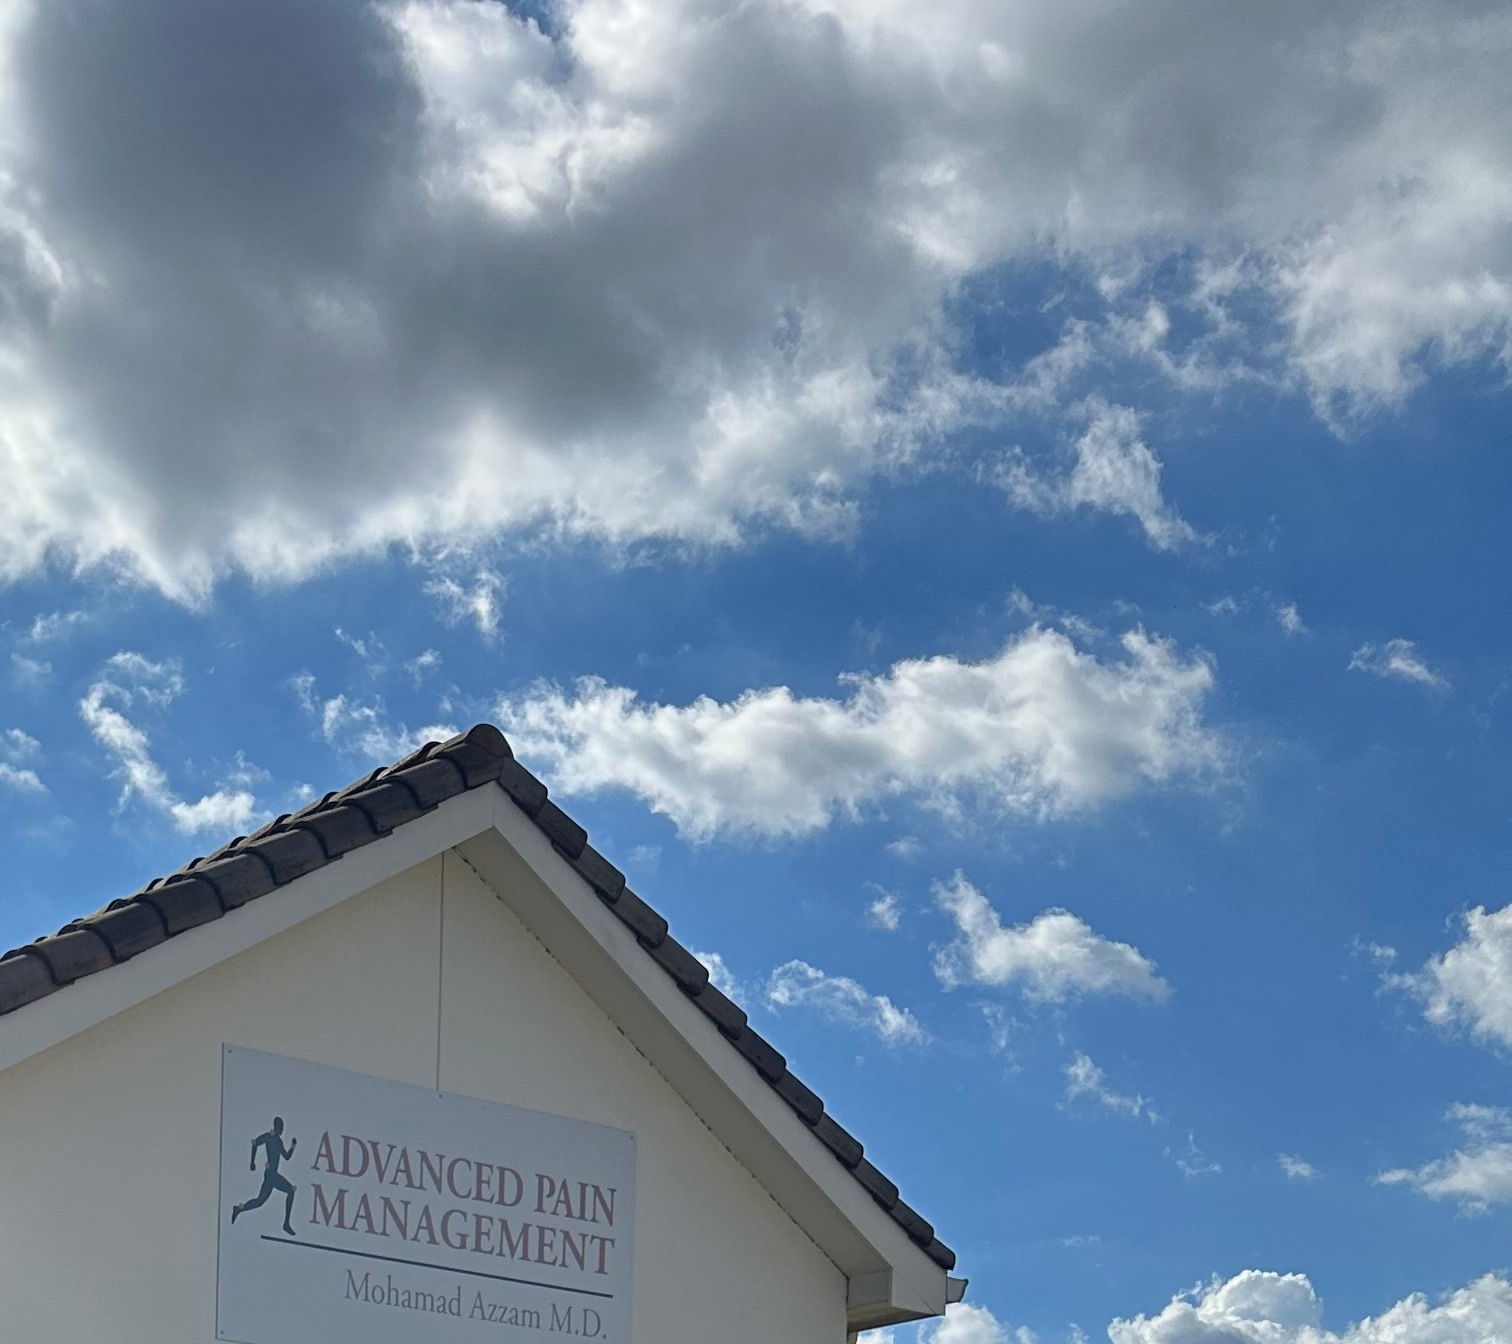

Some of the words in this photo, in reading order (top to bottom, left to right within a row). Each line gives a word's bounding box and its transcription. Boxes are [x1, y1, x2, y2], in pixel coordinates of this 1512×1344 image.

[310, 1130, 524, 1208] ADVANCED
[534, 1173, 617, 1227] PAIN
[308, 1183, 615, 1276] MANAGEMENT
[344, 1268, 461, 1317] Mohamad
[468, 1290, 541, 1329] Azzam
[548, 1303, 607, 1340] M.D.
